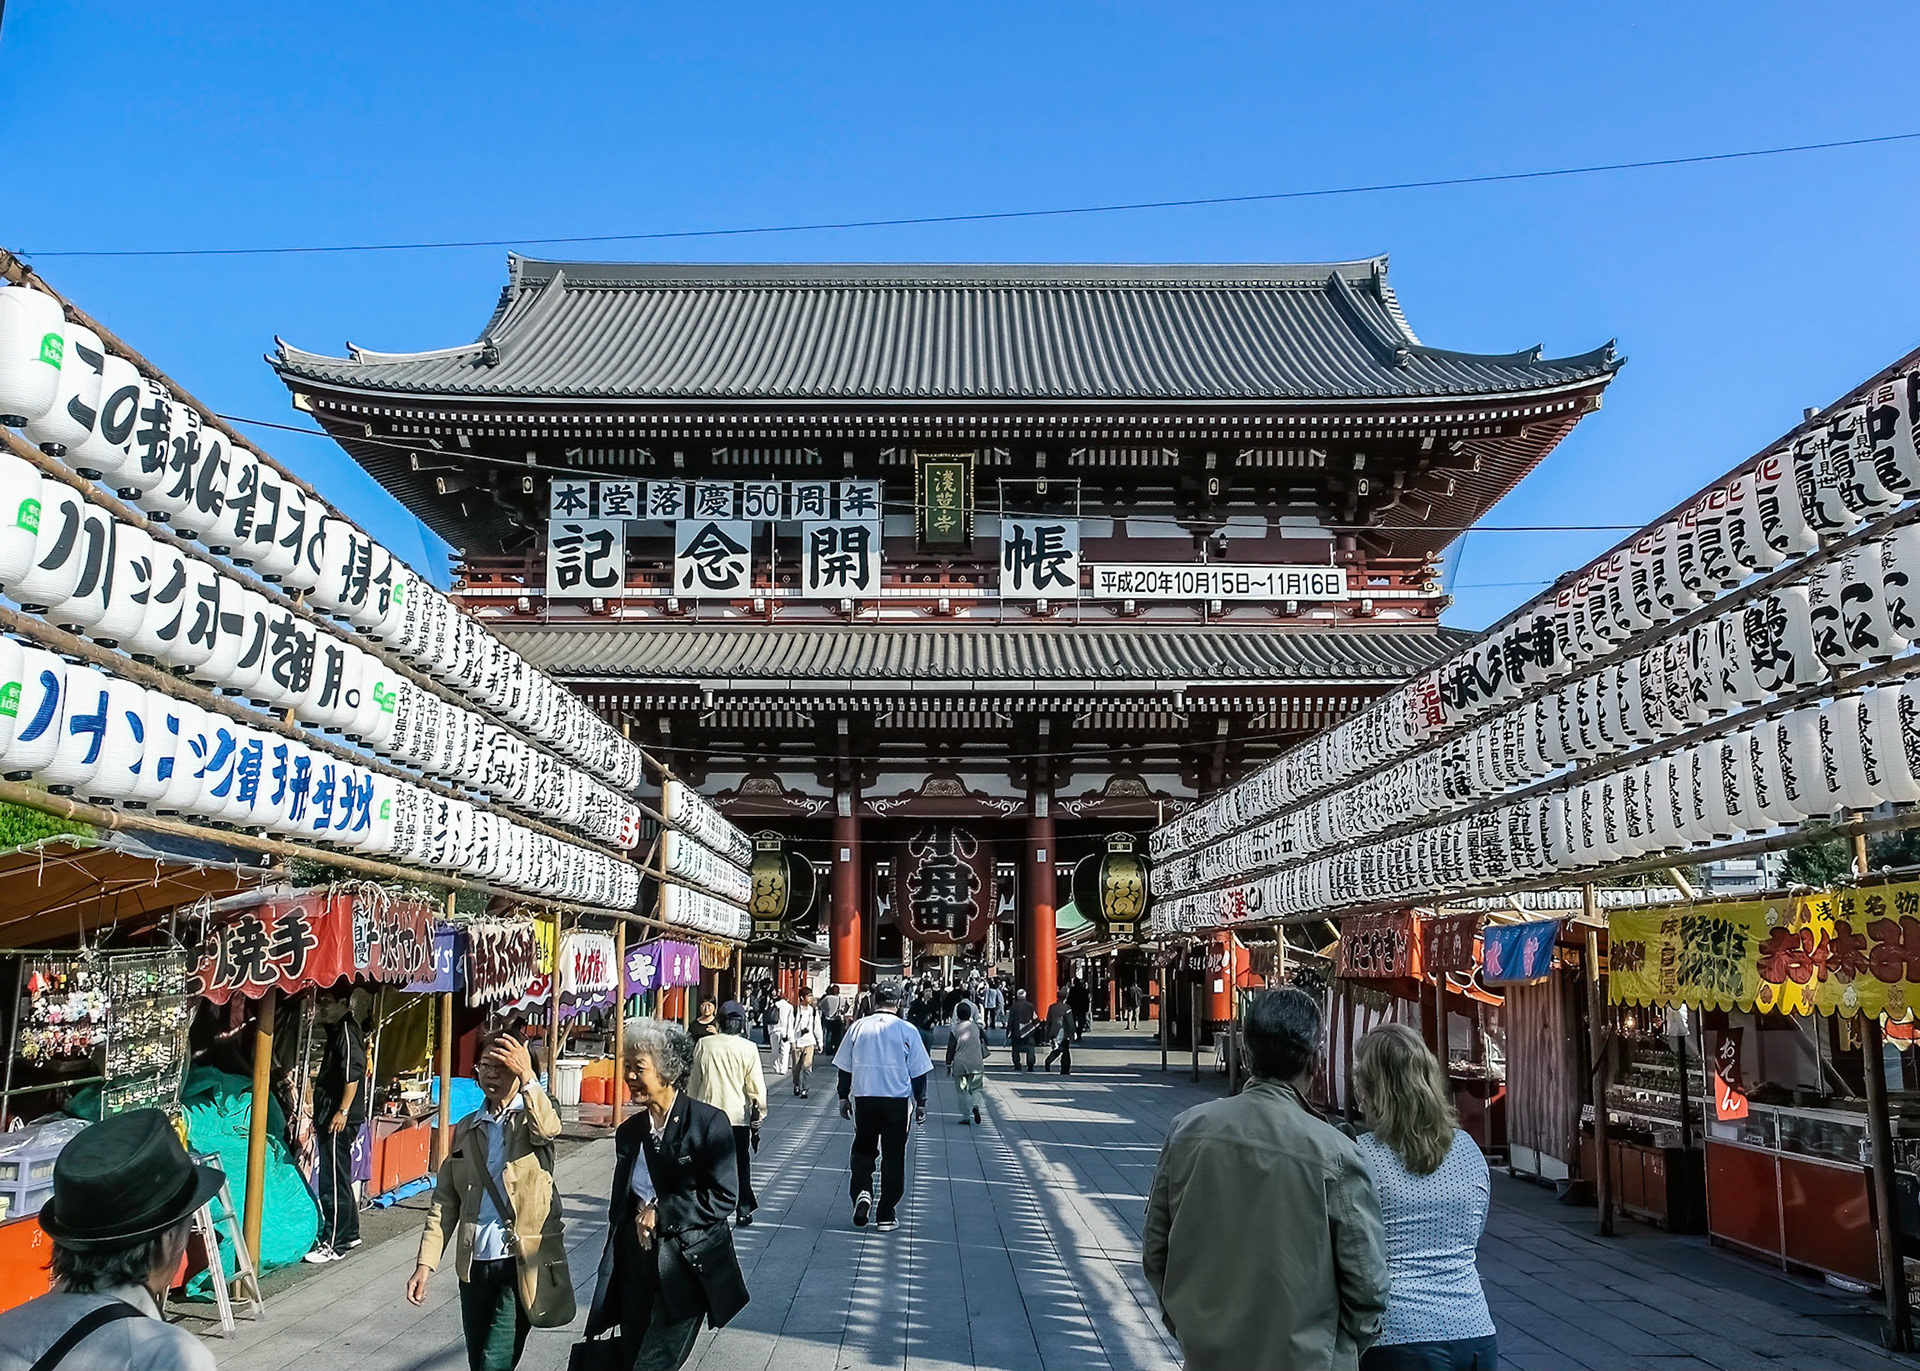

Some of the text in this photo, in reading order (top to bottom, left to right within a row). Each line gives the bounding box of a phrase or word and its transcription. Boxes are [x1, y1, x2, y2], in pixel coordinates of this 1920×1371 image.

[553, 484, 879, 517] 本堂落慶50周年
[1816, 891, 1919, 921] 浅草名物
[1718, 1037, 1742, 1111] おでん
